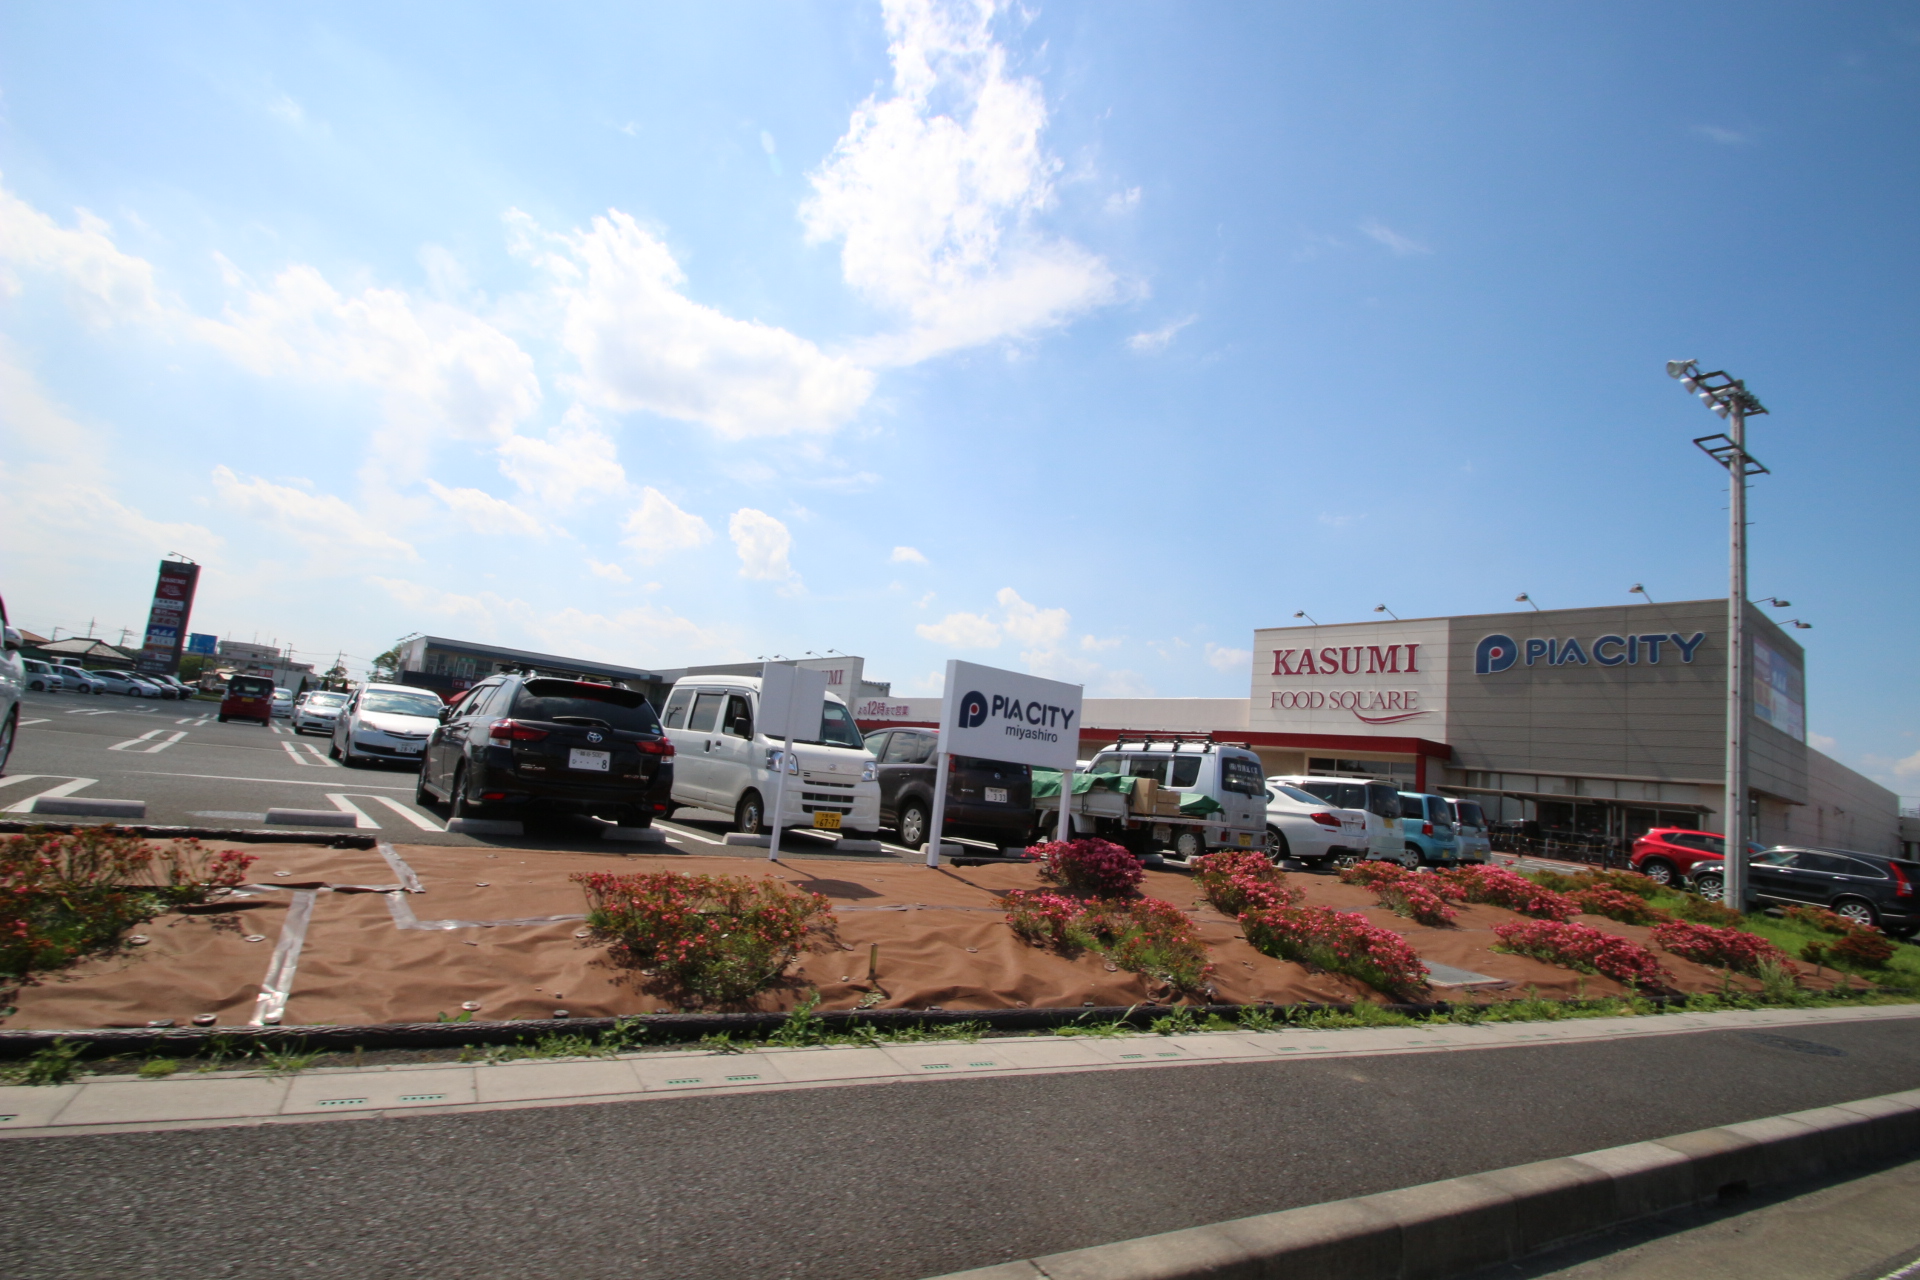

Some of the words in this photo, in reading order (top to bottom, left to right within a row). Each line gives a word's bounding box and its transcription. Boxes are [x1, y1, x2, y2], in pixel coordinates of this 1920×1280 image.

[1271, 643, 1420, 676] KASUMI
[857, 700, 909, 716] よる12時まで営業
[1270, 690, 1325, 709] FOOD
[1328, 690, 1422, 713] SQUARE
[1005, 724, 1058, 743] miyashiro
